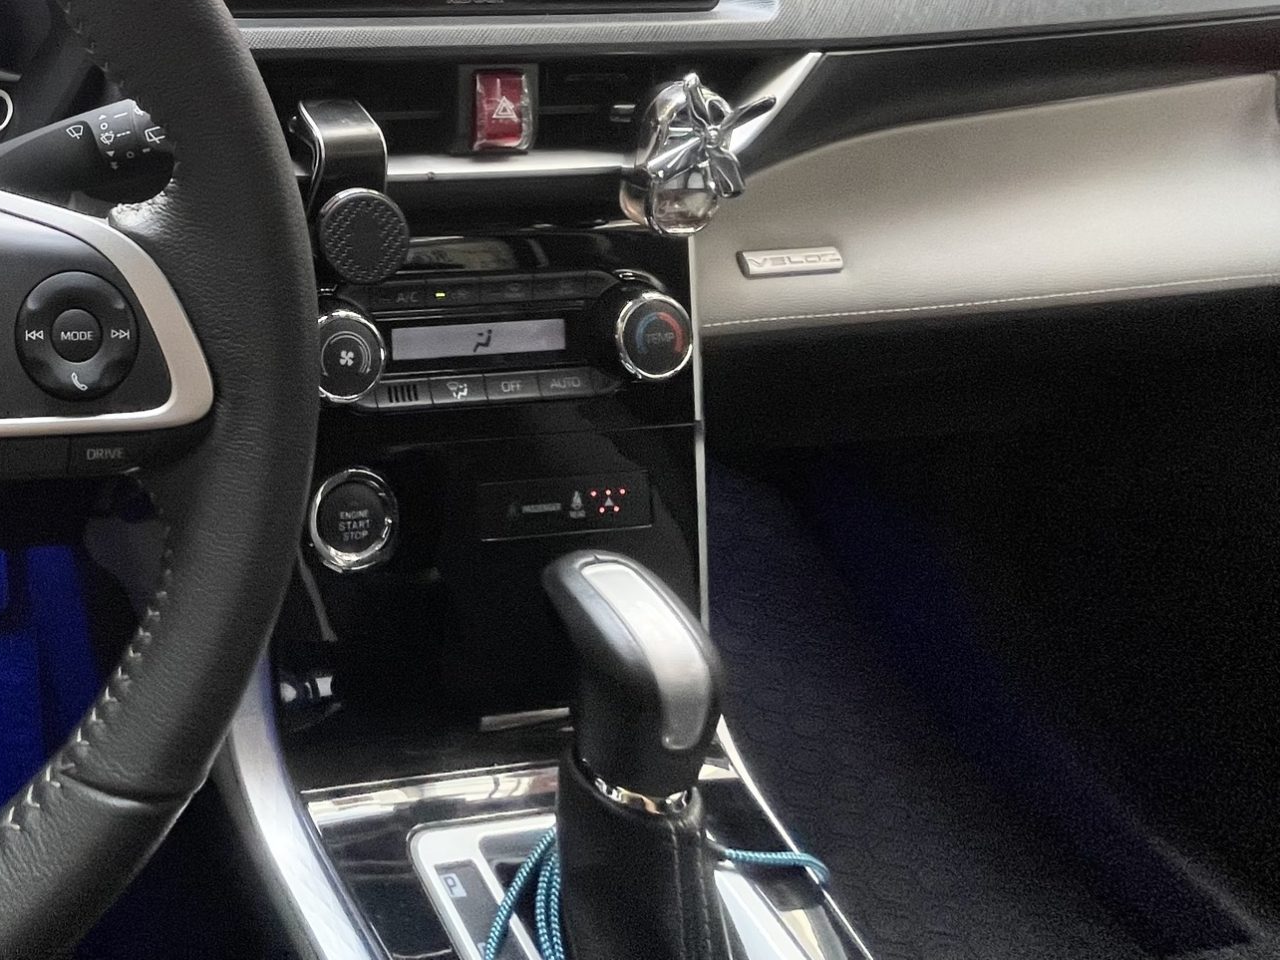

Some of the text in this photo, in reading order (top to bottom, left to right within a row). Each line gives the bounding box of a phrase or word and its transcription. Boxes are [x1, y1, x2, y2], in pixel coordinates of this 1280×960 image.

[60, 331, 94, 341] MODE
[501, 380, 522, 393] OFF
[550, 376, 581, 389] AUTO
[86, 448, 125, 460] DRIVE
[339, 509, 370, 520] ENGINE
[338, 519, 371, 531] START
[342, 530, 369, 541] STOP
[443, 876, 457, 896] P
